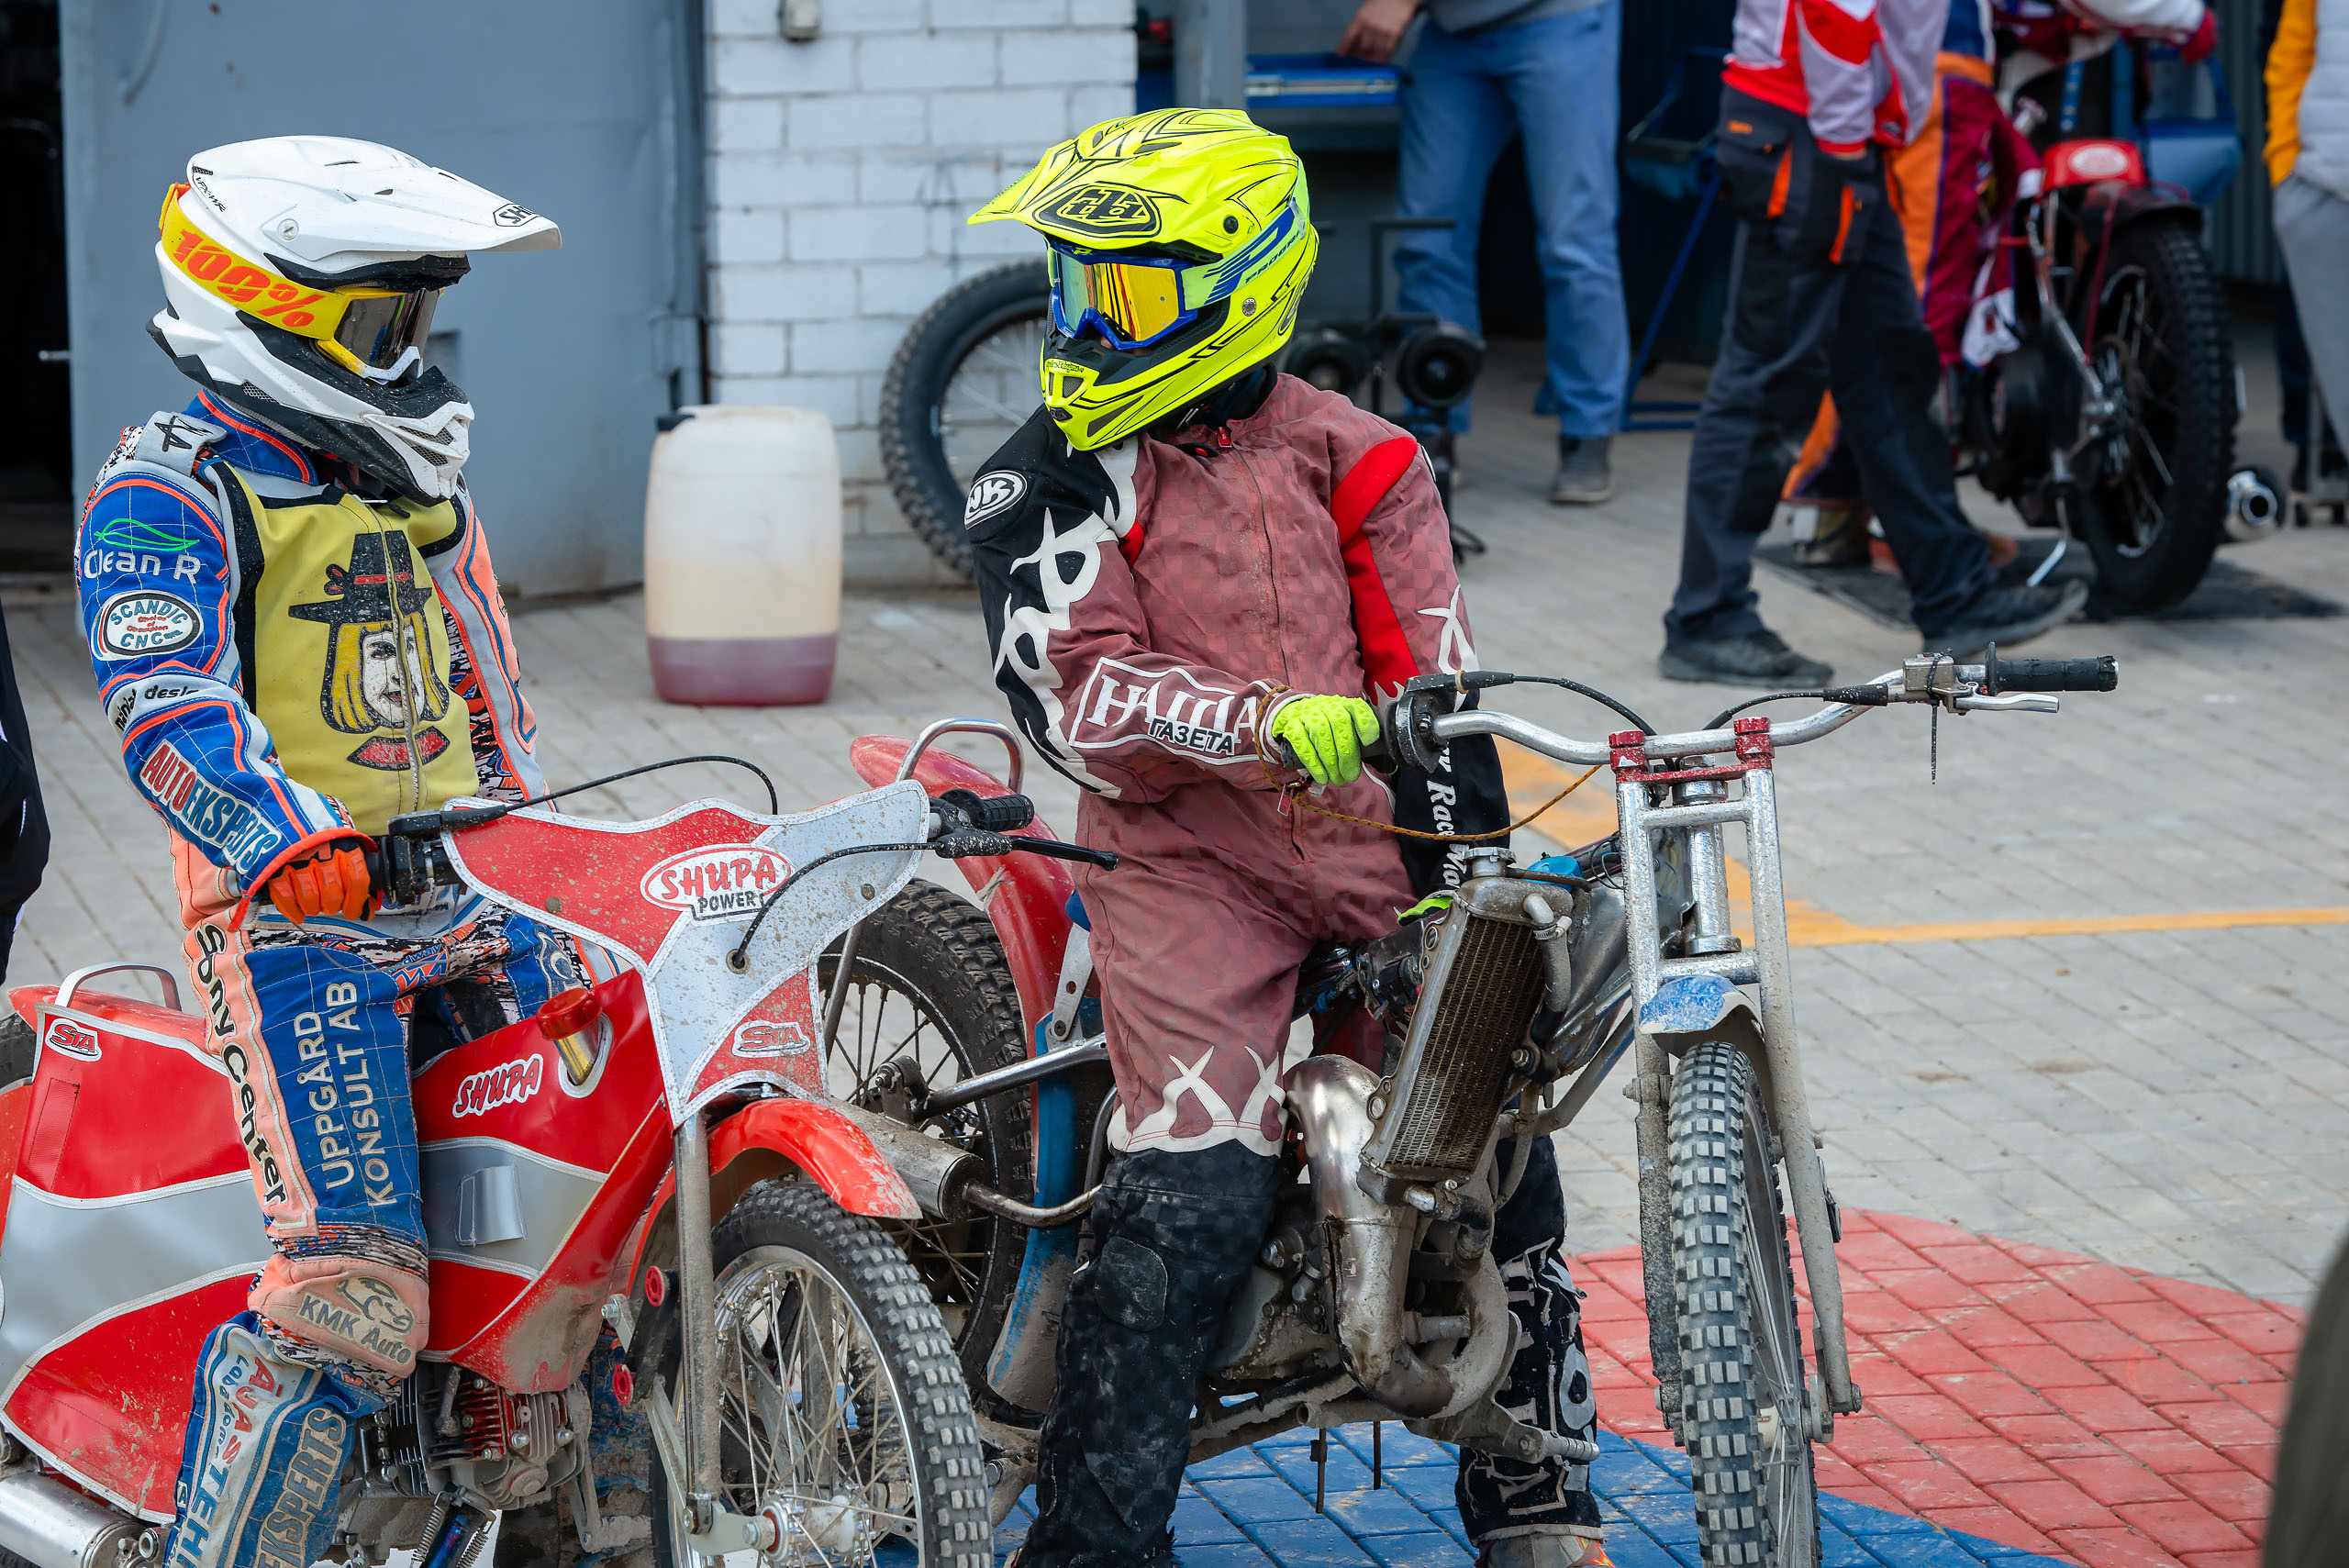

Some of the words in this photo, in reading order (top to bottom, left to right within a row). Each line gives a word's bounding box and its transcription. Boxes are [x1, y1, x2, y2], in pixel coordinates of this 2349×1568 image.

[173, 229, 326, 328] 100%
[83, 549, 161, 579] Clean
[173, 553, 201, 584] R
[110, 599, 188, 625] SCANDIC
[120, 632, 163, 649] CNC
[1086, 674, 1258, 744] НАША
[1149, 717, 1233, 754] ГАЗЕТА
[661, 855, 776, 900] SHUPA
[698, 890, 756, 914] POWER
[327, 982, 361, 1031] AB
[50, 1024, 95, 1053] STA
[197, 925, 236, 1038] Sony
[223, 1044, 287, 1205] Center
[456, 1059, 540, 1113] SHUPA
[295, 1012, 355, 1189] UPPGÅRD
[337, 1043, 397, 1207] KONSULT
[299, 1296, 361, 1339] KMK
[361, 1328, 412, 1363] Auto
